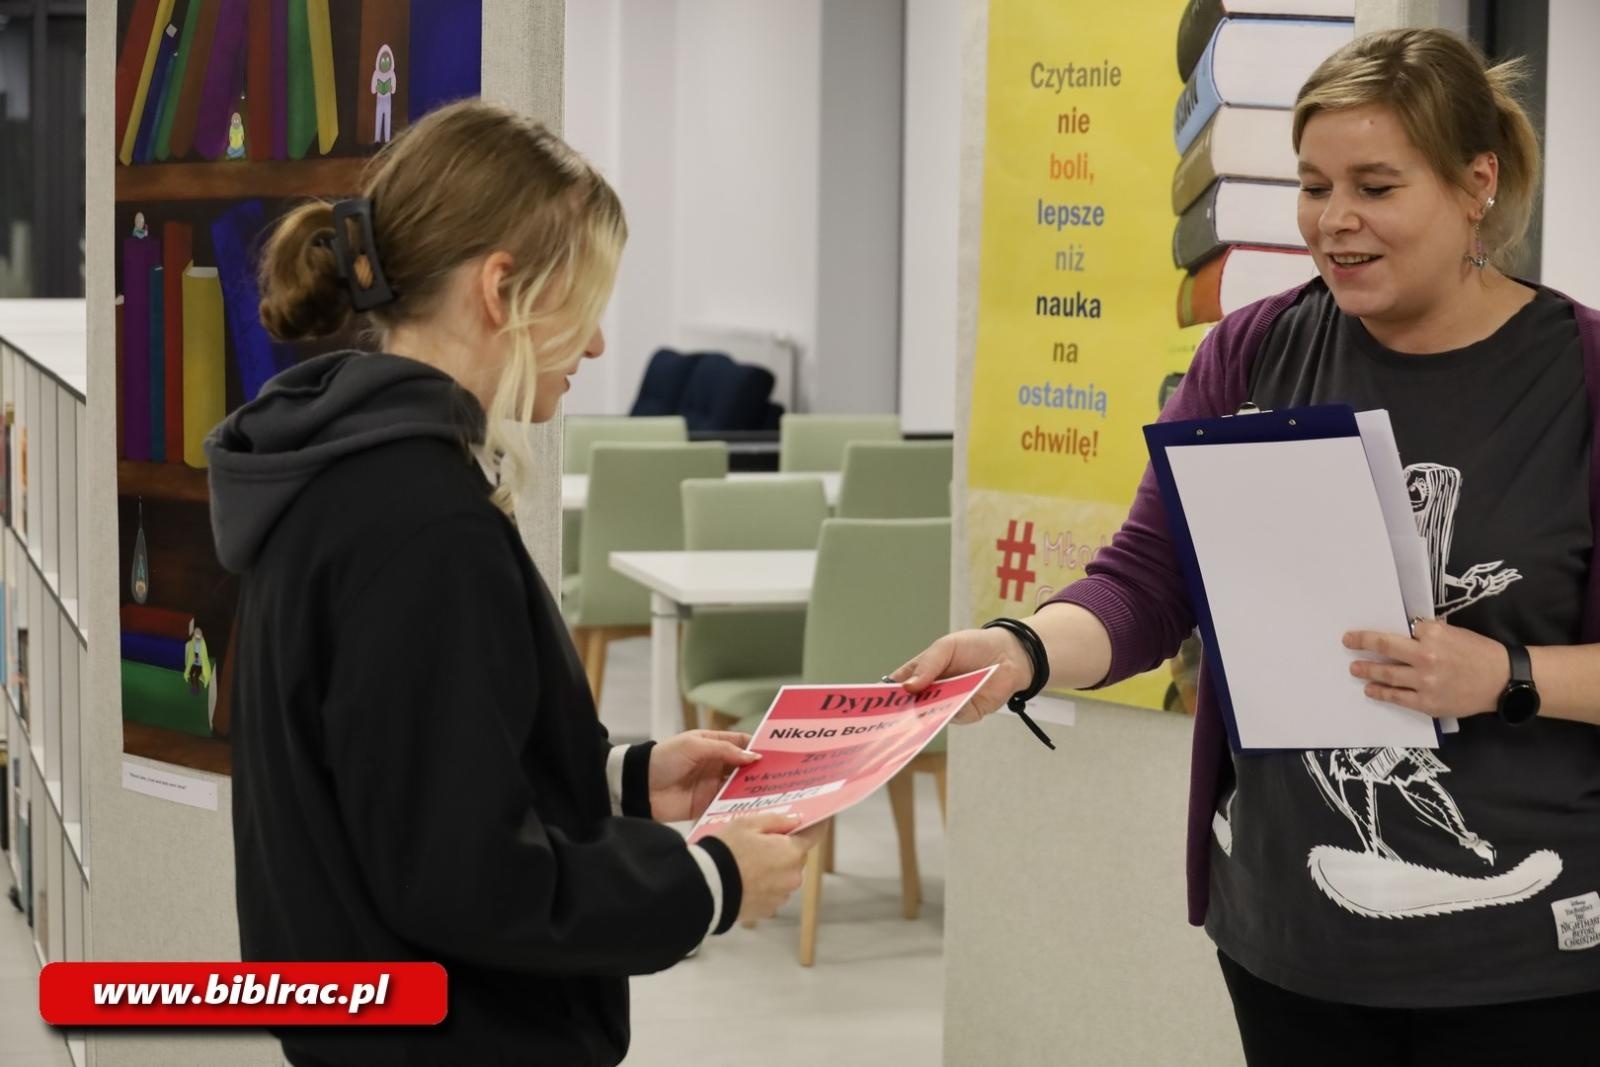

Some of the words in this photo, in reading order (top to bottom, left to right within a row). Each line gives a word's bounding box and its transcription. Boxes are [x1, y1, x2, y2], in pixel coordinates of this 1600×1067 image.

[1030, 60, 1122, 95] Czytanie
[1057, 106, 1091, 134] nie
[1049, 152, 1094, 184] boli,
[1037, 198, 1105, 231] lepsze
[1055, 243, 1085, 271] niż
[1036, 291, 1101, 319] nauka
[1052, 341, 1079, 363] na
[1018, 382, 1108, 418] ostatnią
[1020, 425, 1099, 463] chwilę!
[819, 688, 943, 714] Dyplom
[769, 727, 837, 740] Nikola
